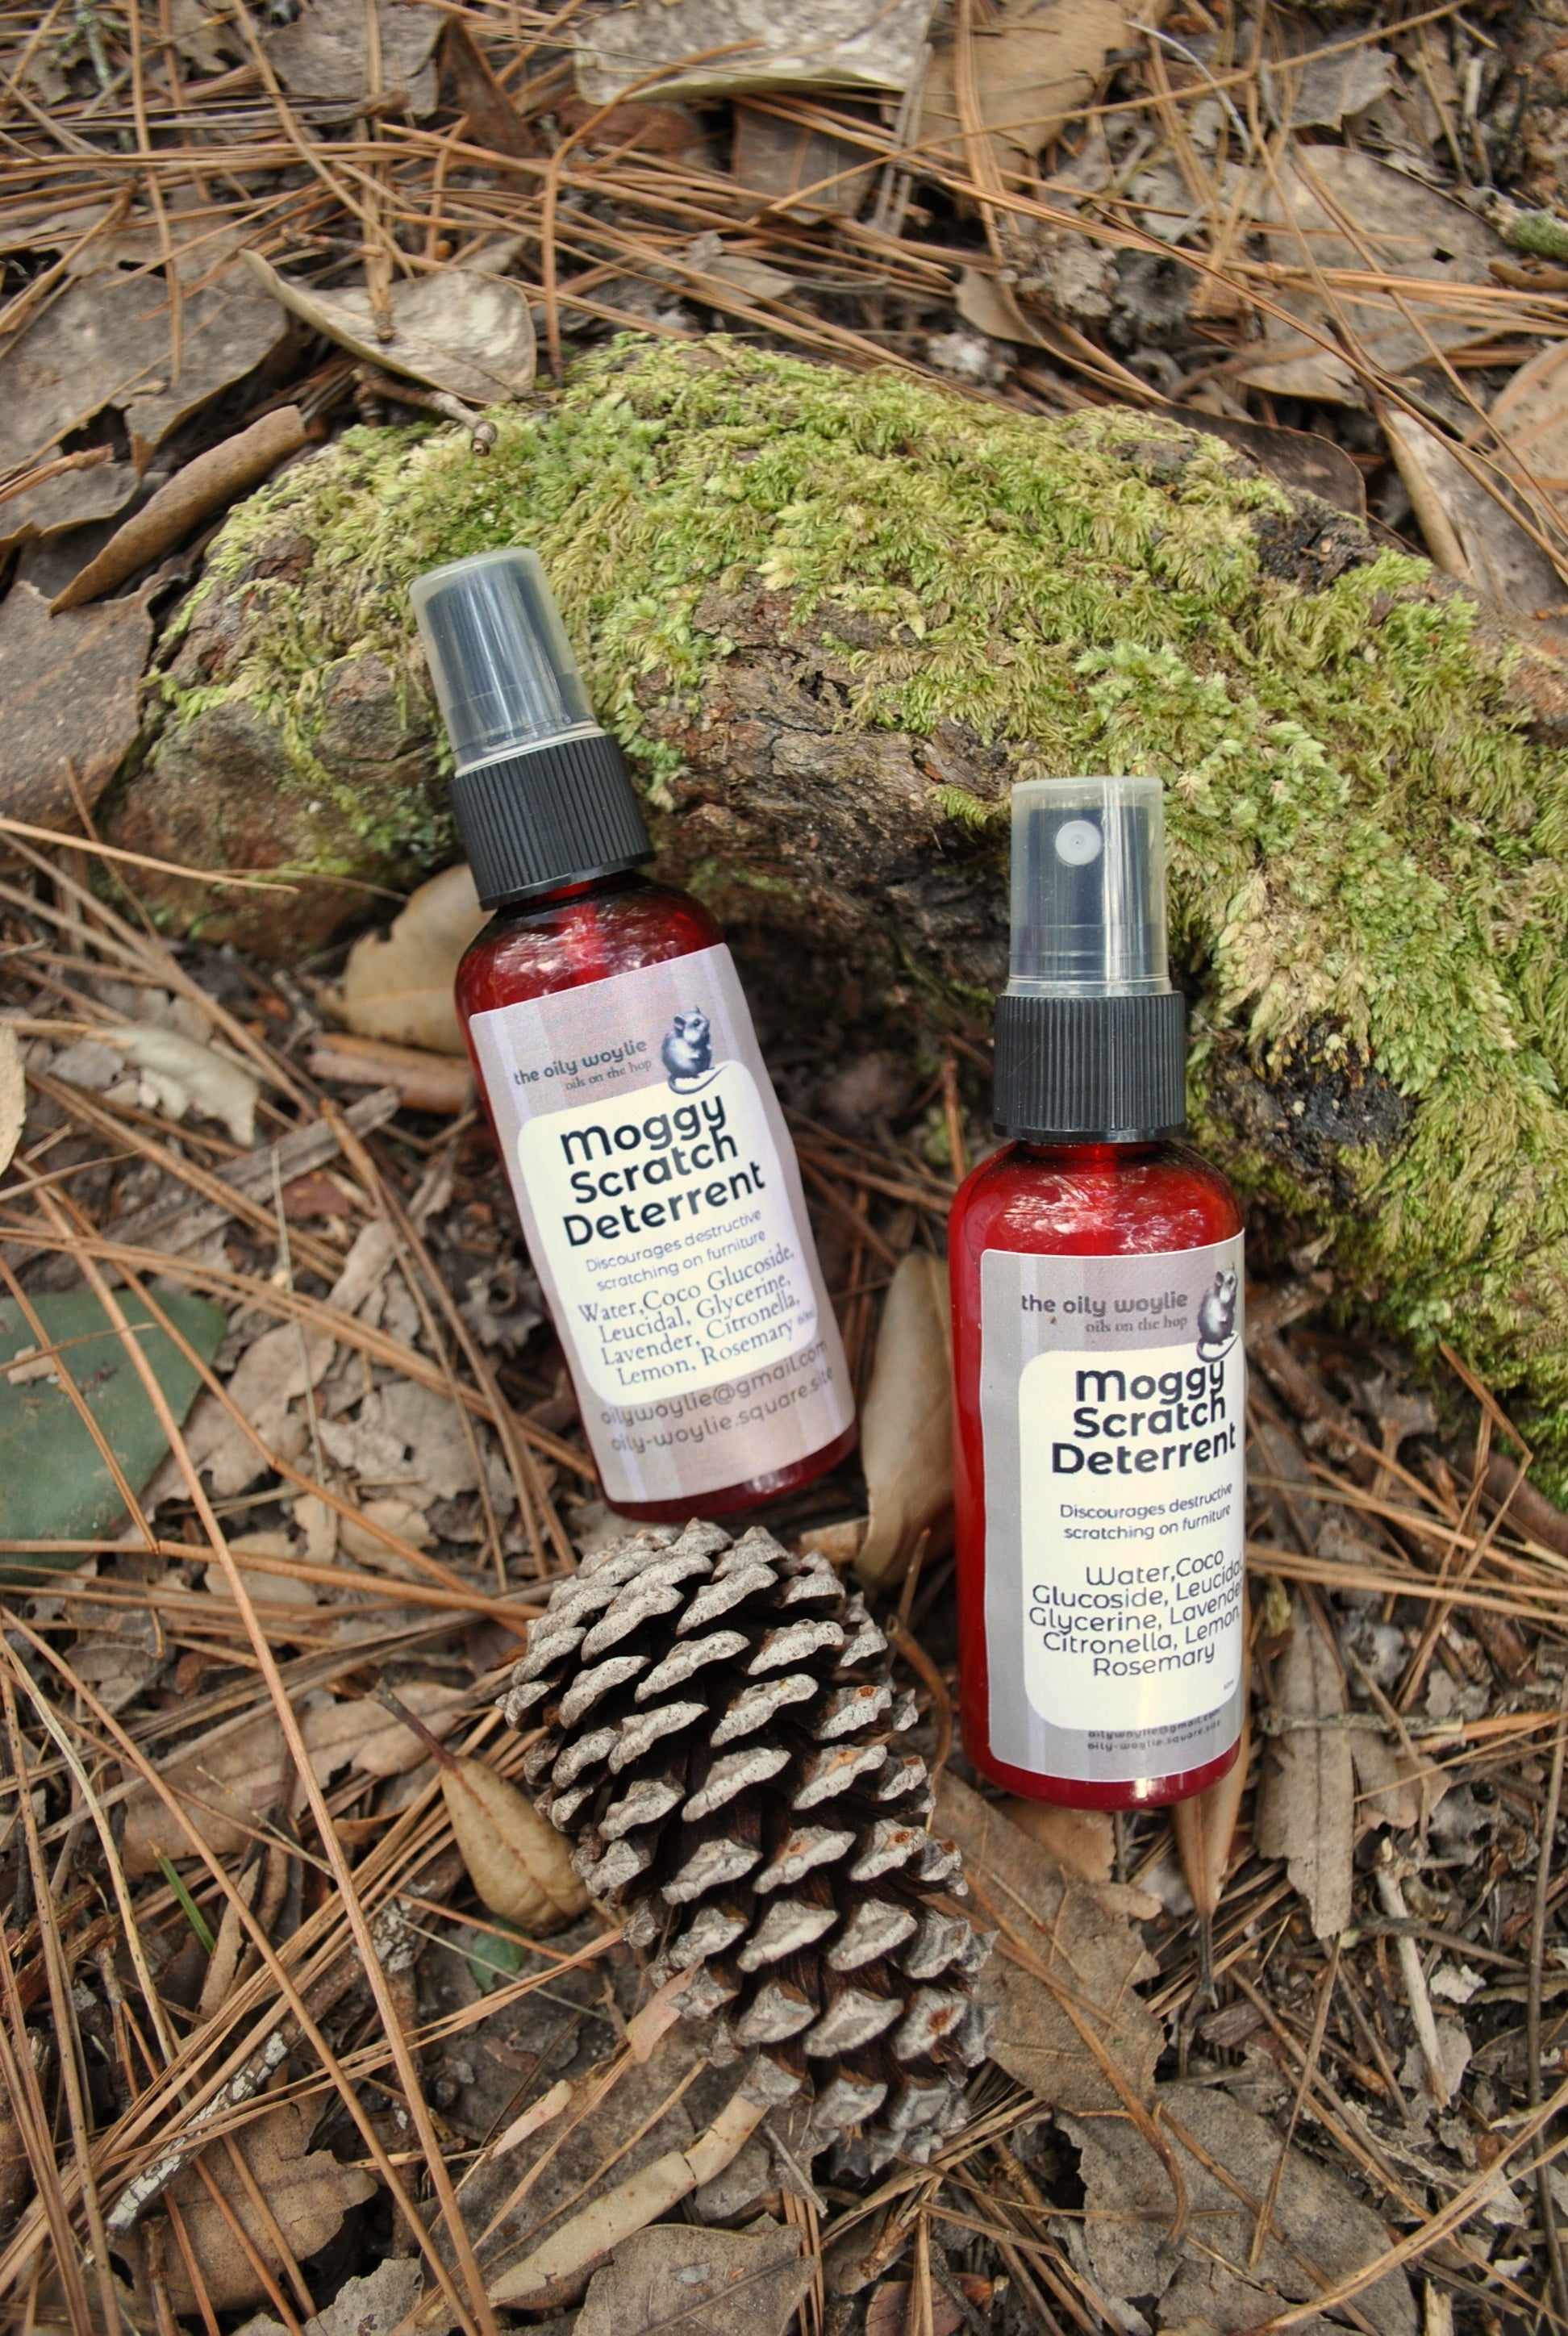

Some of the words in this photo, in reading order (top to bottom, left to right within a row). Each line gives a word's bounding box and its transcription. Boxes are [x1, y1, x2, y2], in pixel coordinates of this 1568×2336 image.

[514, 1070, 539, 1085] the
[544, 1060, 578, 1075] oily
[582, 1040, 648, 1067] woylie
[565, 1077, 586, 1090] oils
[588, 1073, 604, 1084] on
[607, 1066, 626, 1079] the
[628, 1060, 653, 1074] hop
[570, 1128, 738, 1204] Scratch
[563, 1161, 765, 1246] Deterrent
[586, 1238, 682, 1272] Discourages
[684, 1209, 761, 1246] destructive
[597, 1262, 679, 1291] scratching
[683, 1255, 703, 1270] on
[707, 1228, 766, 1262] furniture
[598, 1305, 691, 1343] Leucidal,
[696, 1273, 791, 1319] Glycerine,
[1021, 1295, 1056, 1313] the
[1063, 1296, 1107, 1317] oily
[1115, 1291, 1189, 1315] woylie
[1085, 1320, 1111, 1333] oils
[1116, 1321, 1134, 1333] on
[1138, 1316, 1160, 1332] the
[1163, 1315, 1189, 1331] hop
[600, 1333, 701, 1366] Lavender,
[617, 1356, 697, 1386] Lemon,
[700, 1317, 793, 1367] Rosemary
[600, 1339, 828, 1428] oilywoylie@gmail.com
[611, 1366, 834, 1454] oily-woylie.square.site
[1074, 1388, 1226, 1438] Scratch
[1052, 1422, 1236, 1475] Deterrent
[1060, 1504, 1166, 1520] Discourages
[1169, 1483, 1232, 1513] destructive
[1064, 1525, 1155, 1540] scratching
[1159, 1523, 1178, 1536] on
[1182, 1504, 1231, 1532] furniture
[1029, 1606, 1162, 1635] Glycerine,
[1032, 1584, 1169, 1608] Glucoside,
[1043, 1630, 1178, 1654] Citronella,
[1185, 1605, 1240, 1644] Lemon
[1093, 1642, 1216, 1676] Rosemary
